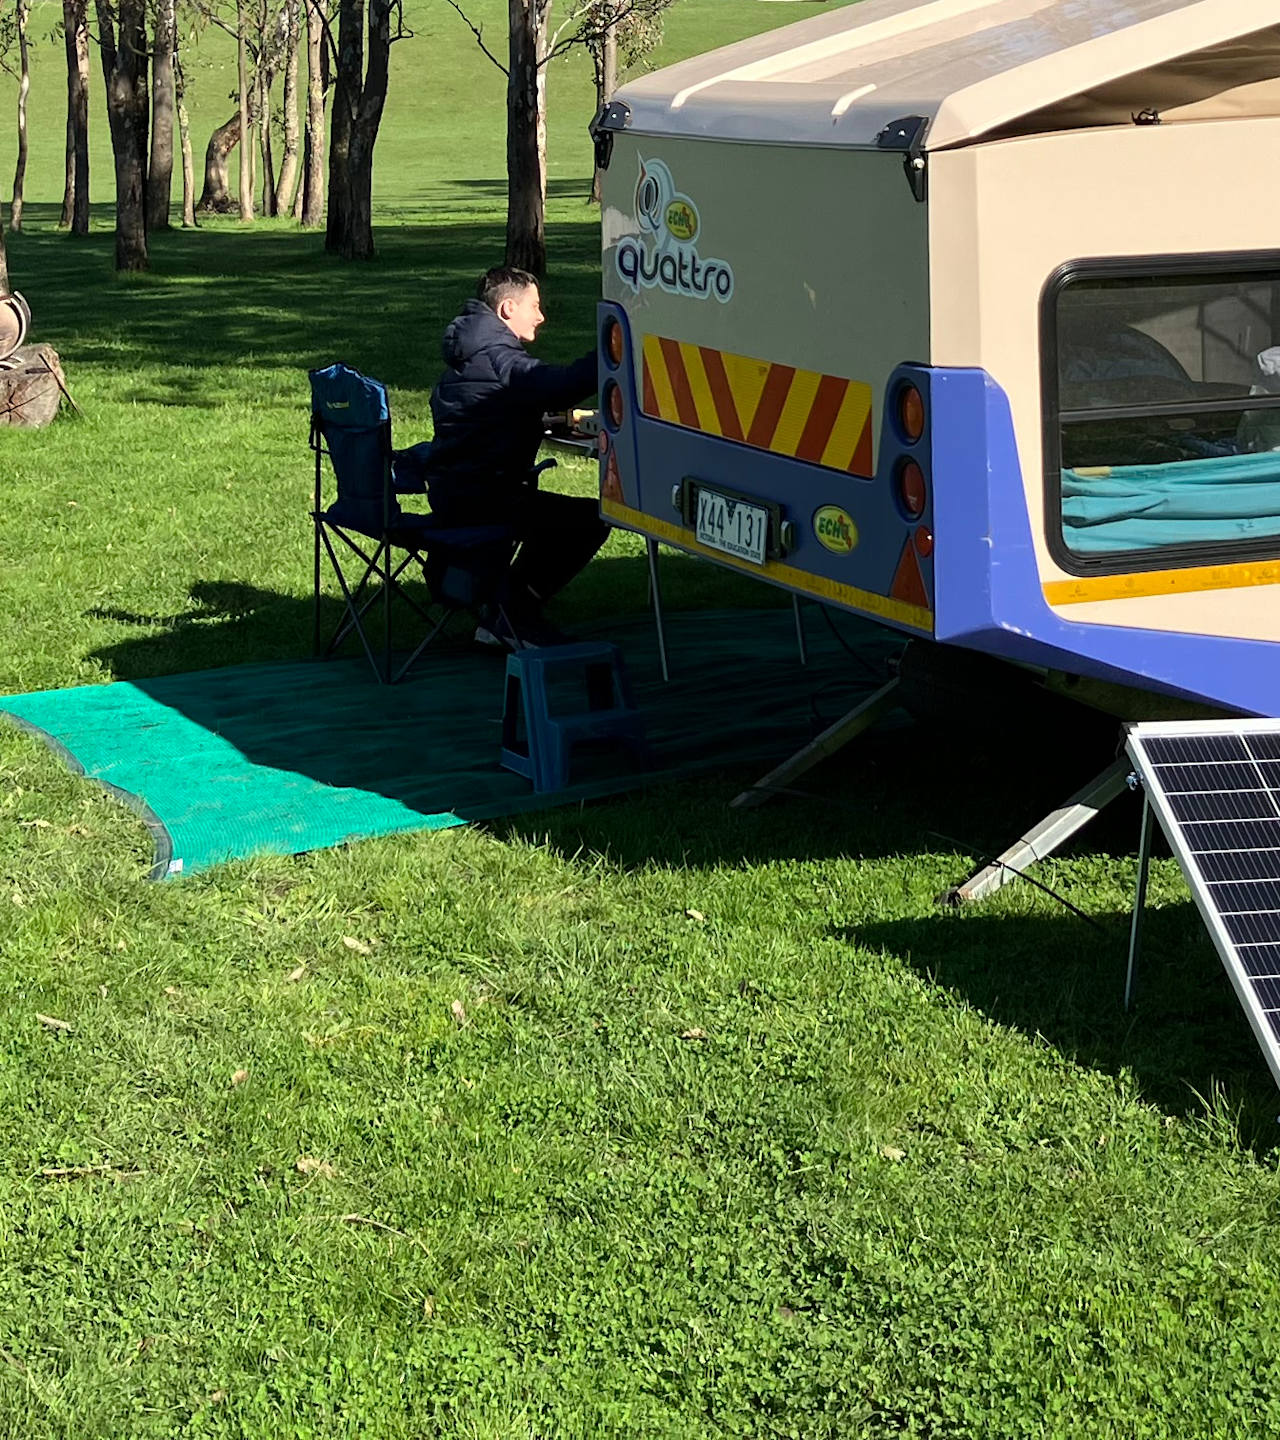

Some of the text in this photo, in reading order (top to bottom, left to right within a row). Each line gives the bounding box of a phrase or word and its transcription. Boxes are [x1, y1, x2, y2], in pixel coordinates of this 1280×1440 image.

[618, 244, 730, 295] quattro
[699, 497, 763, 551] X44 131
